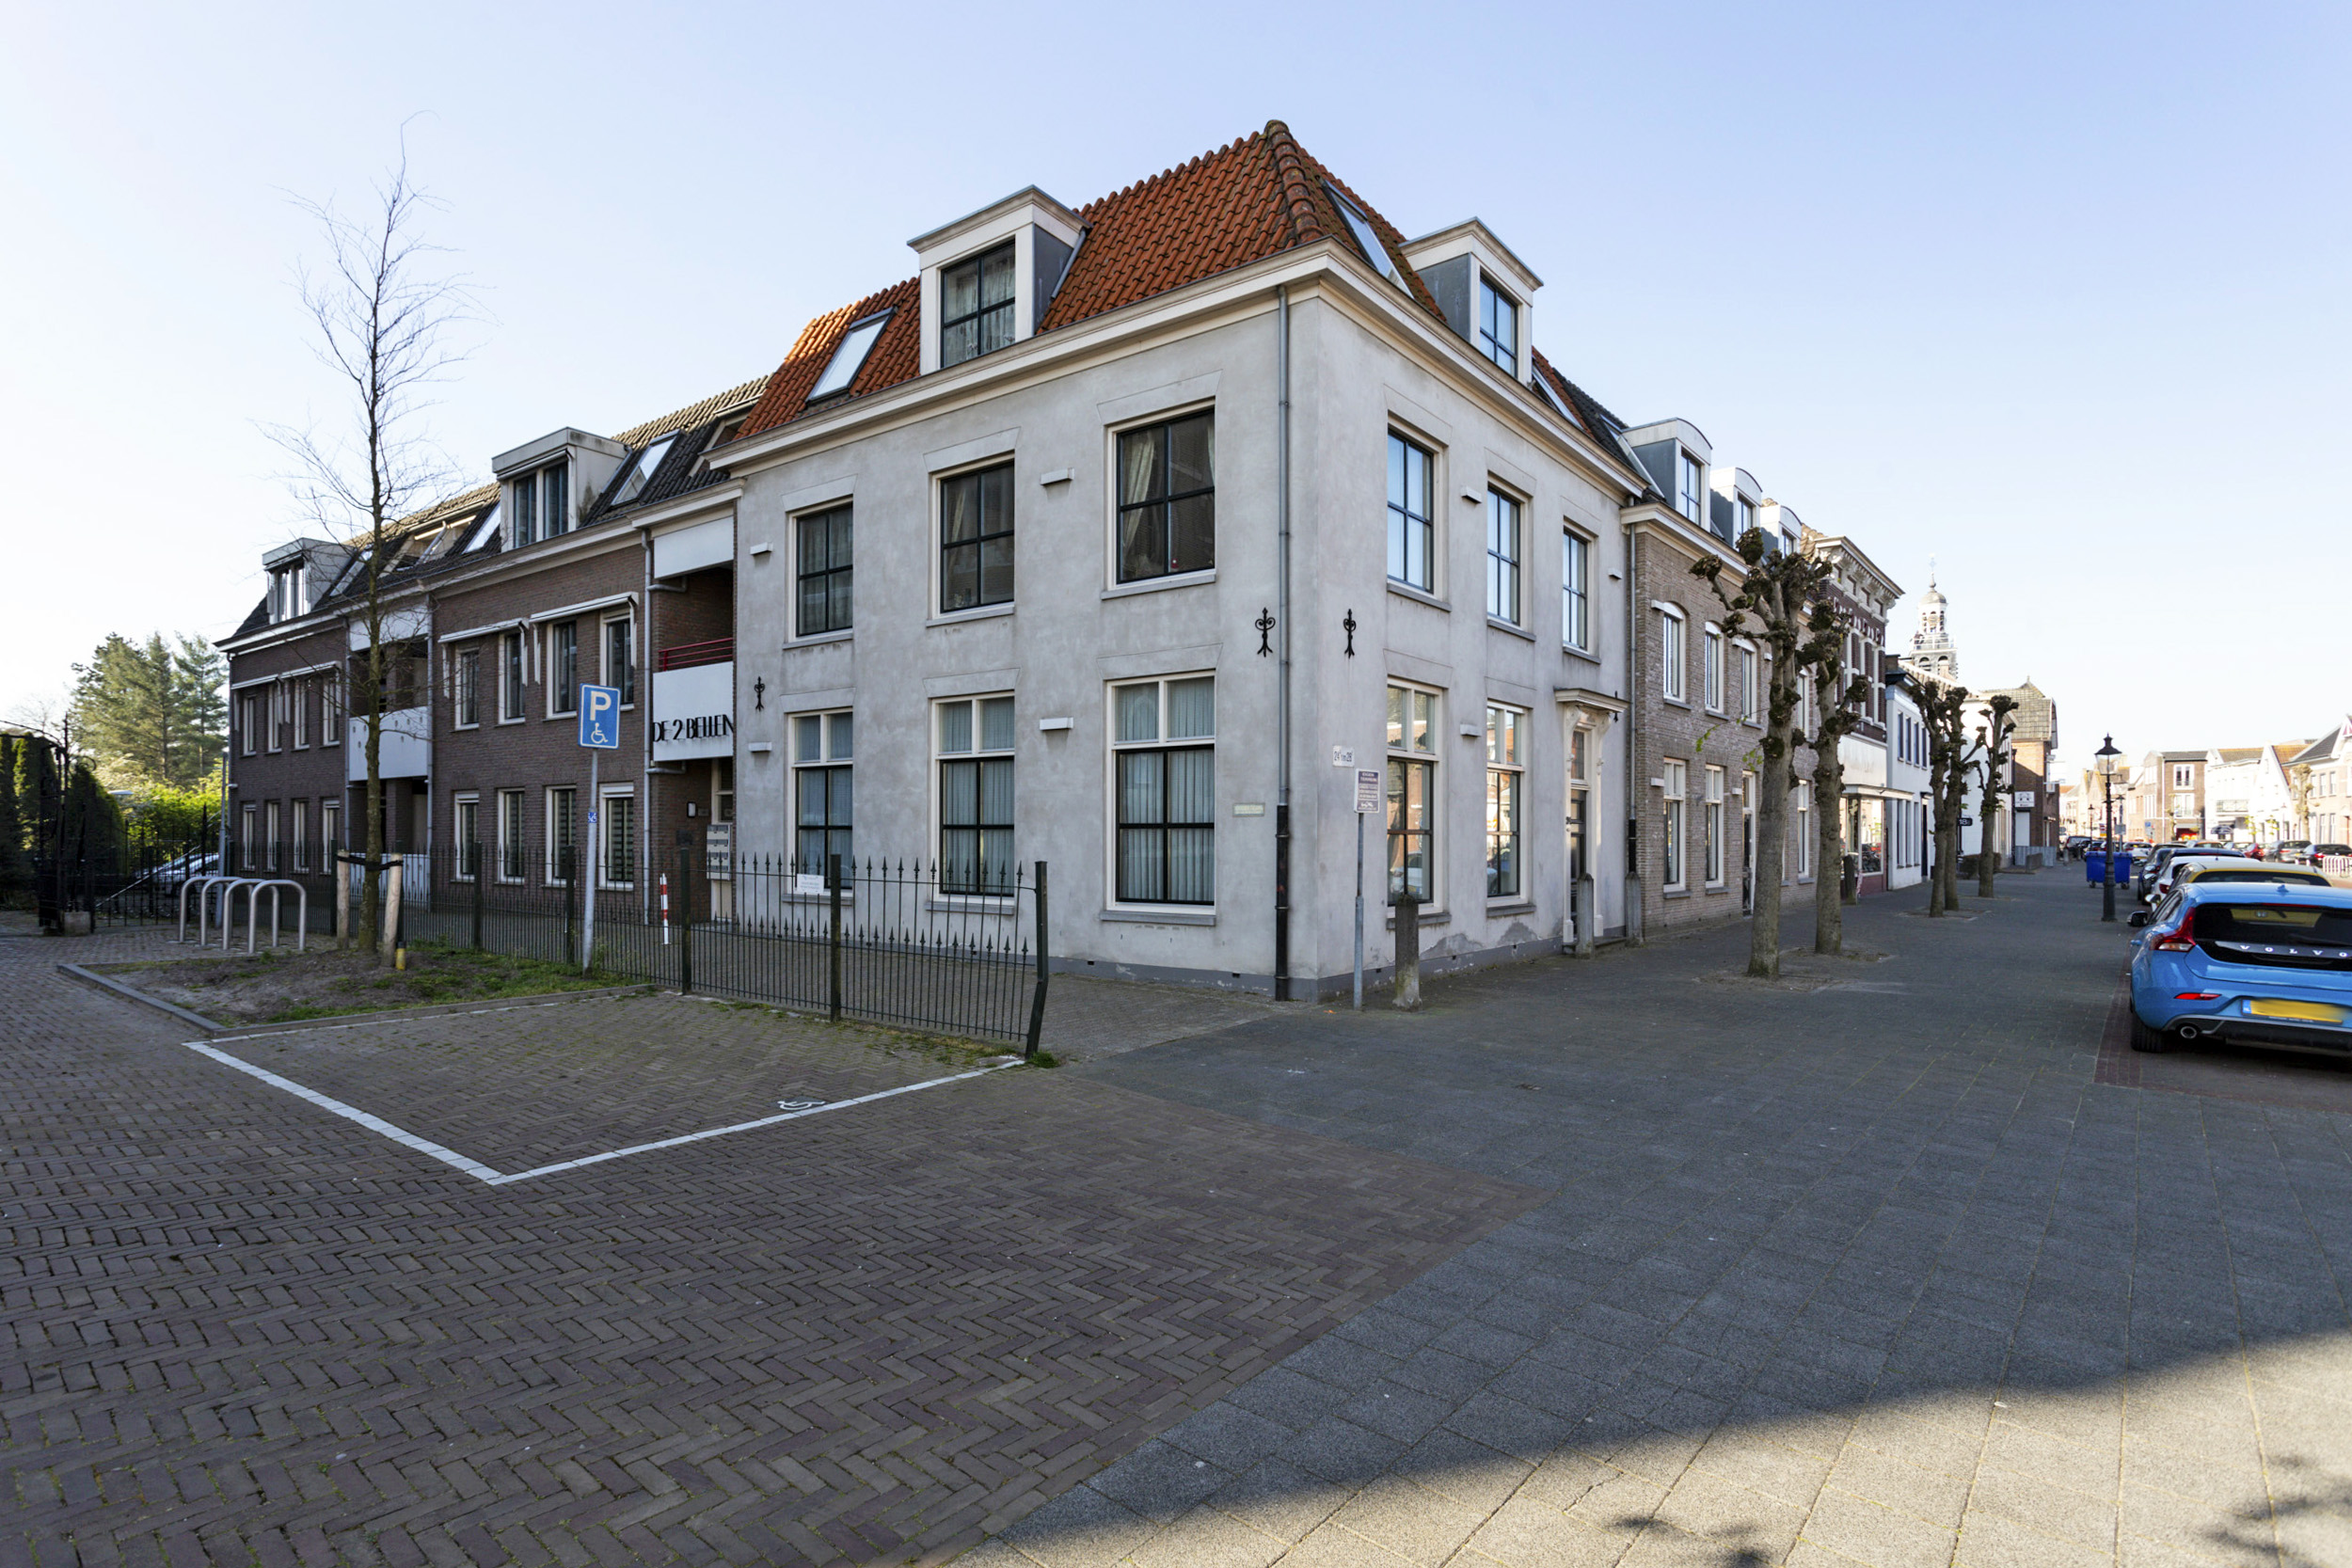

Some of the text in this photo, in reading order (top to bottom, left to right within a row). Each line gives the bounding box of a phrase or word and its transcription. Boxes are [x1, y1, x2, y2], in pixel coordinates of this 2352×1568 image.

[590, 690, 612, 721] P
[653, 721, 672, 742] DE
[673, 719, 685, 740] 2
[2239, 944, 2348, 958] VOLVO
